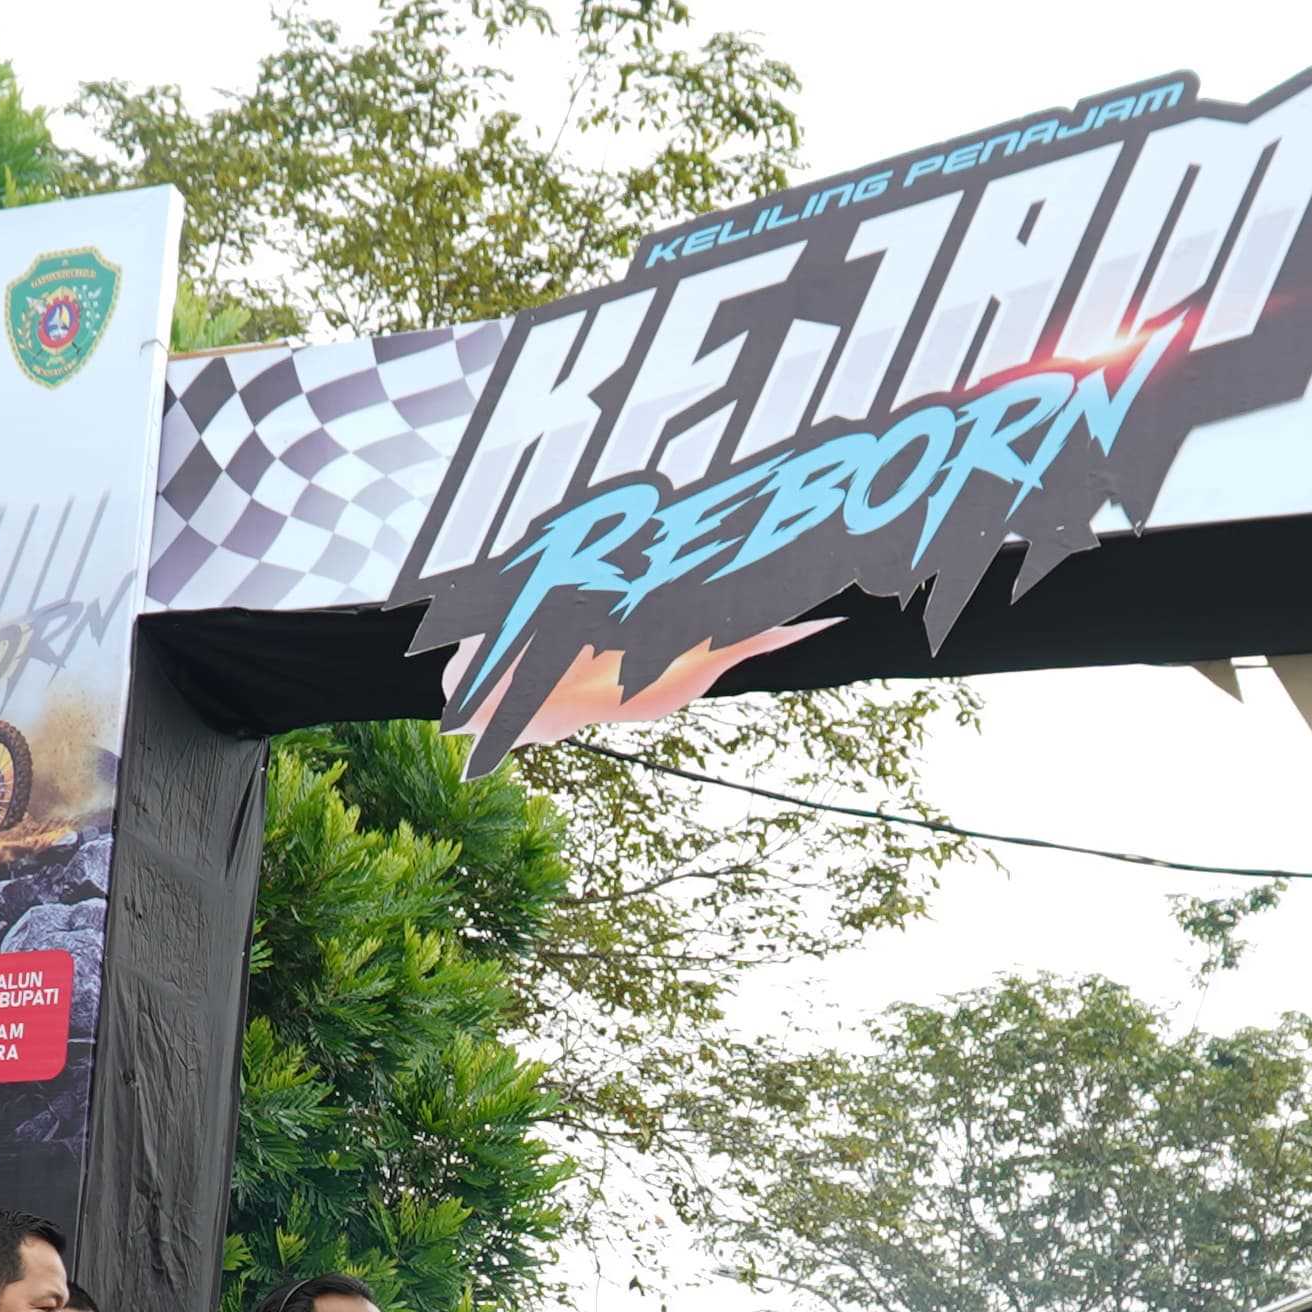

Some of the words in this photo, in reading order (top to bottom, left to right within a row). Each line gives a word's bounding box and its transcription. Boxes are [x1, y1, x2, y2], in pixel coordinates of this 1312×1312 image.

[645, 167, 888, 269] KELILING
[906, 81, 1186, 178] PENAJAM
[459, 326, 1178, 713] REBORN
[0, 988, 59, 1008] BUPATI
